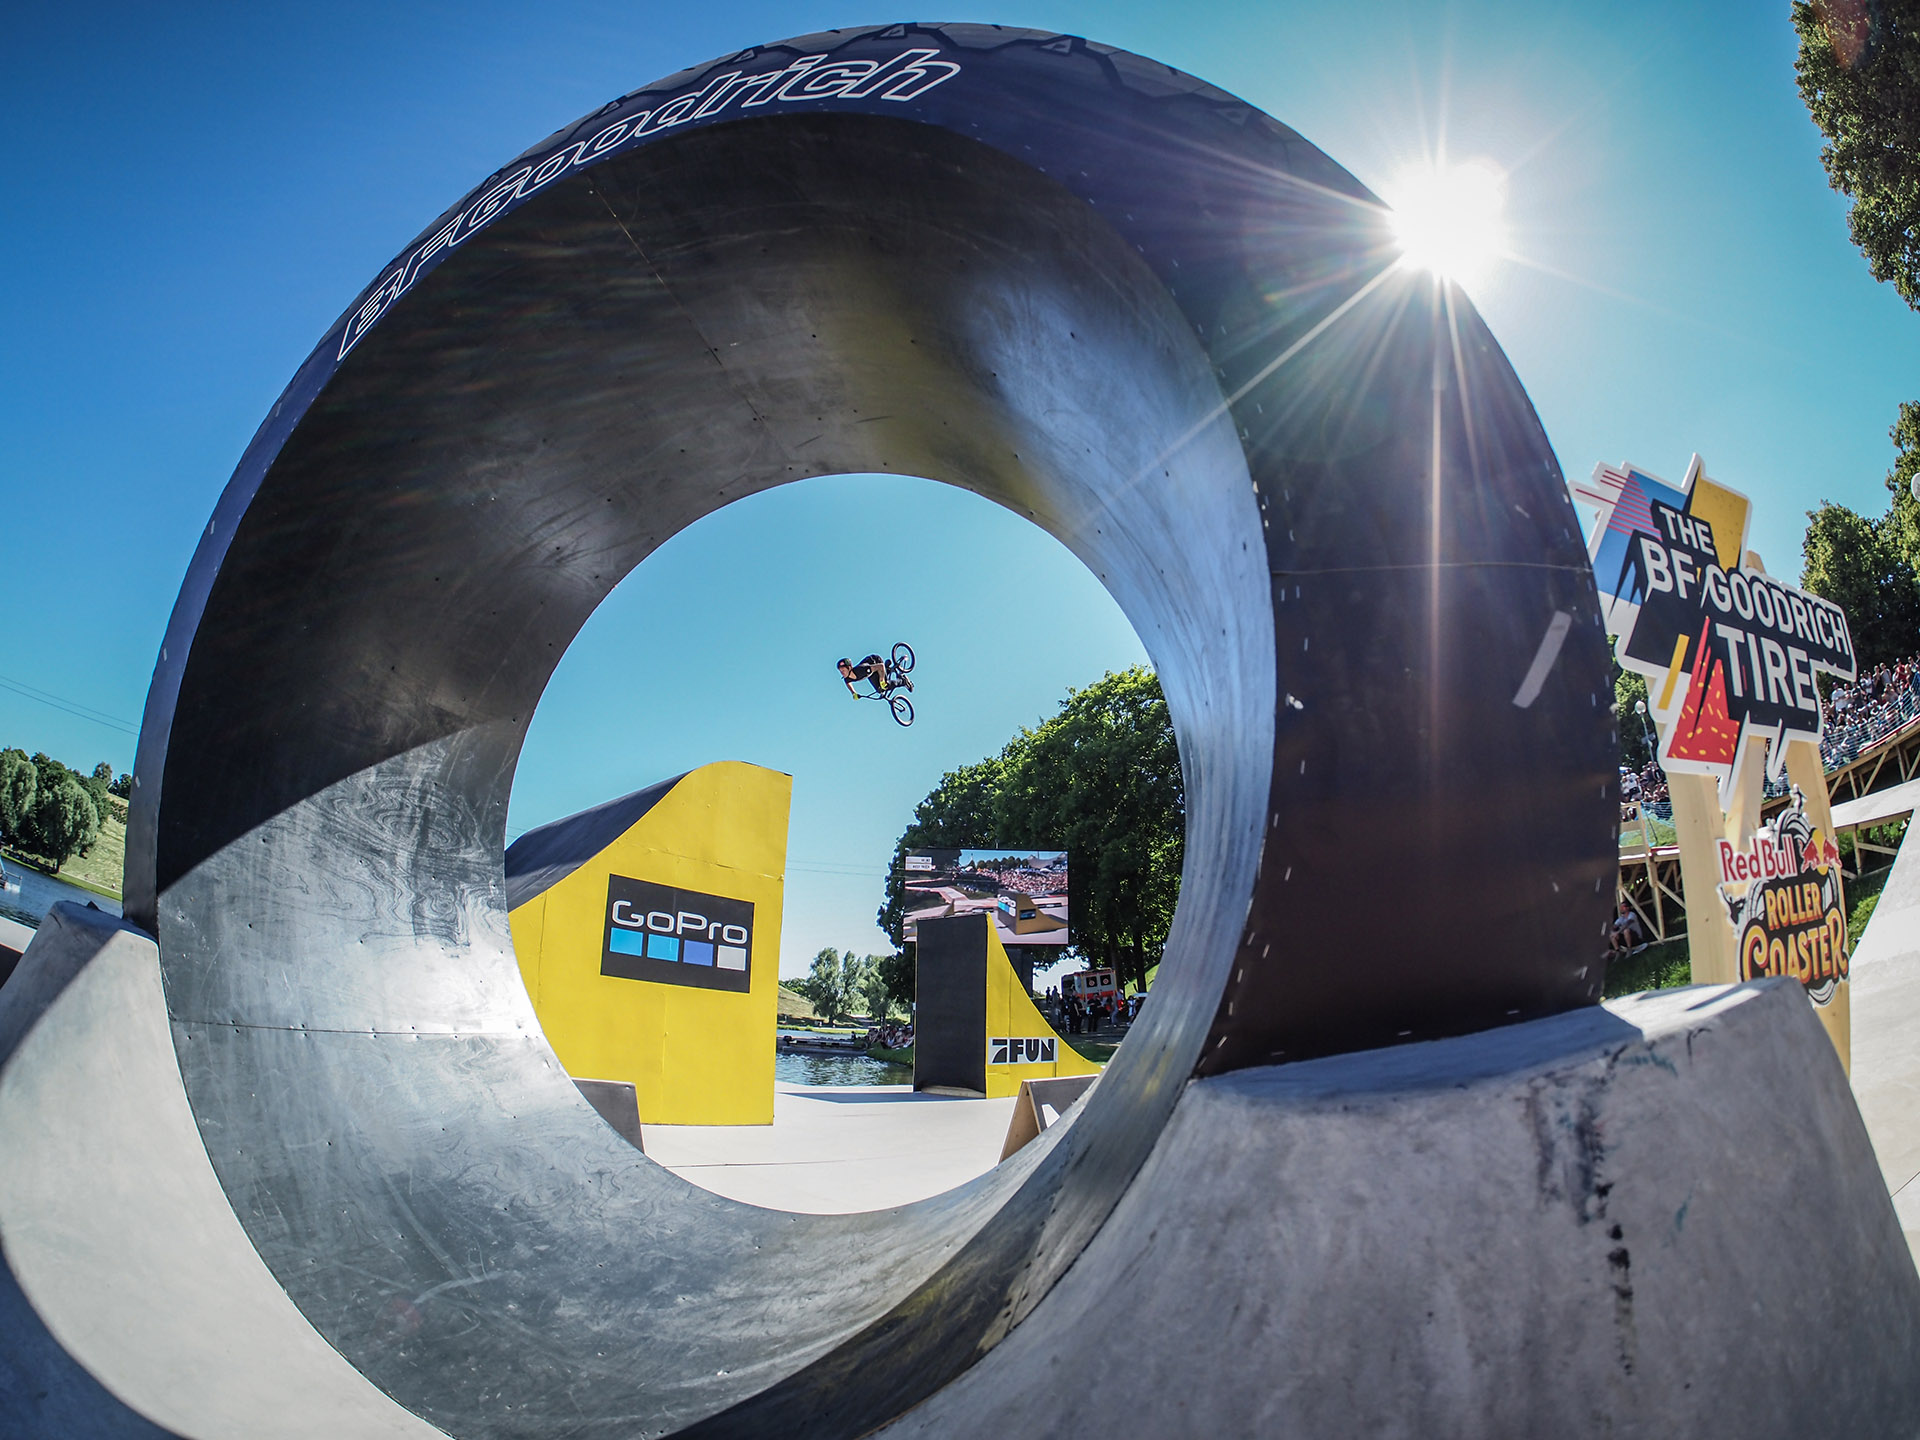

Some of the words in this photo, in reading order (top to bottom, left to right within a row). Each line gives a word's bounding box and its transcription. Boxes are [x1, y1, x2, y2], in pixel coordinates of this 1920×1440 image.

[1658, 505, 1715, 556] THE
[1715, 622, 1817, 712] TIRE
[1719, 837, 1761, 882] Red
[1760, 835, 1797, 877] Bull
[611, 900, 748, 945] GoPro
[1764, 881, 1824, 931] ROLLER
[1742, 907, 1849, 984] COASTER
